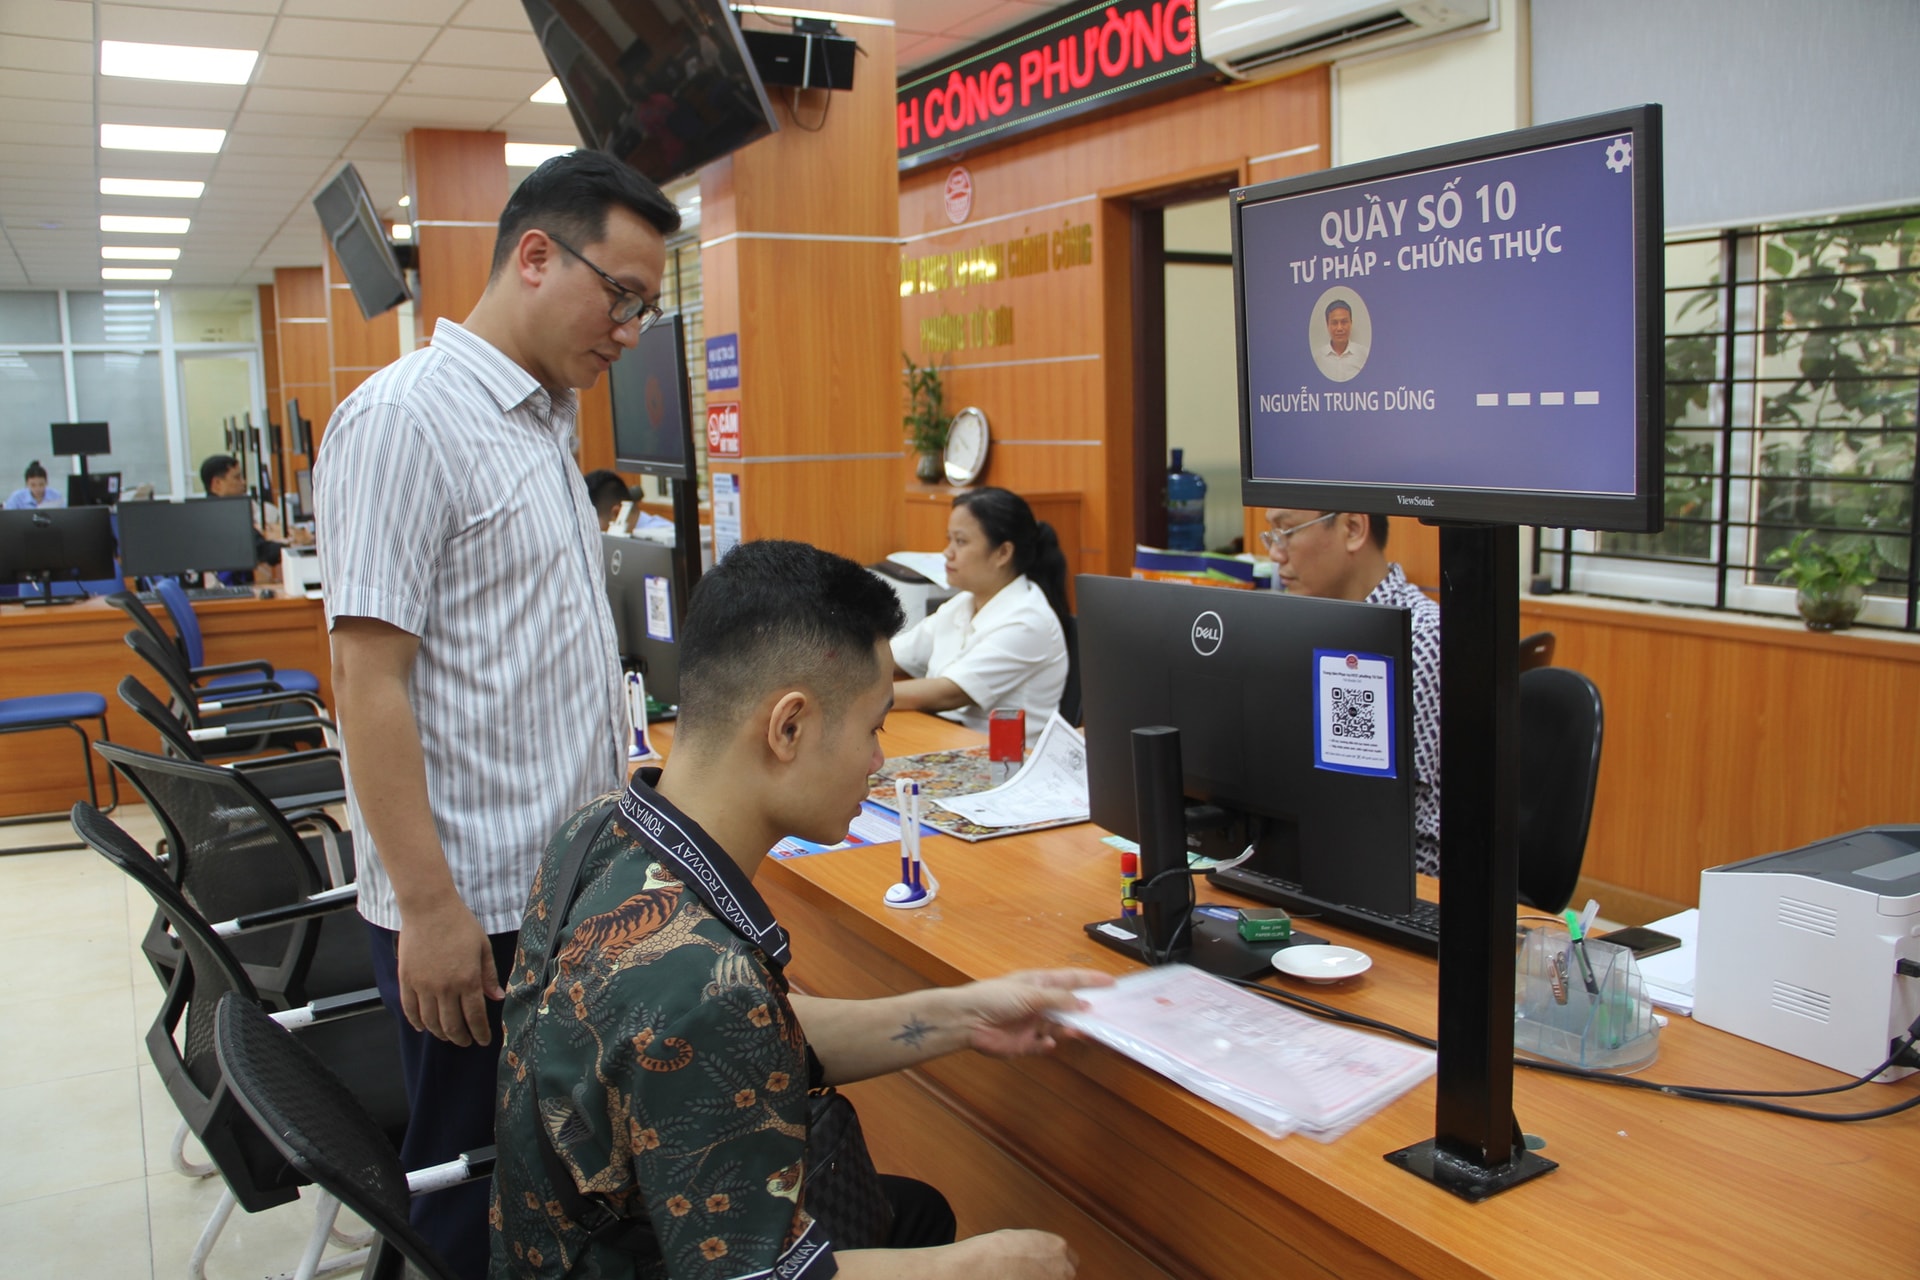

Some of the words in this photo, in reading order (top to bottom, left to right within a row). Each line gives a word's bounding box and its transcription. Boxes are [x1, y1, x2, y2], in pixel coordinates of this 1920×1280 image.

[924, 70, 1014, 139] CÔNG
[1019, 0, 1195, 107] PHƯỜNG
[1320, 193, 1408, 249] QUẦY
[1417, 176, 1463, 233] SỐ
[1475, 181, 1517, 223] 10
[1290, 256, 1317, 284] TƯ
[1322, 246, 1377, 281] PHÁP
[1397, 235, 1482, 271] CHỨNG
[1489, 224, 1562, 262] THỰC
[1260, 386, 1320, 413] NGUYỄN
[1324, 391, 1379, 412] TRUNG
[1384, 386, 1435, 411] DŨNG
[1396, 495, 1435, 507] ViewSonic
[1195, 626, 1219, 640] DELL
[628, 801, 666, 838] ROWAY
[671, 842, 720, 892] ROWAY
[776, 1239, 818, 1279] ROWAY
